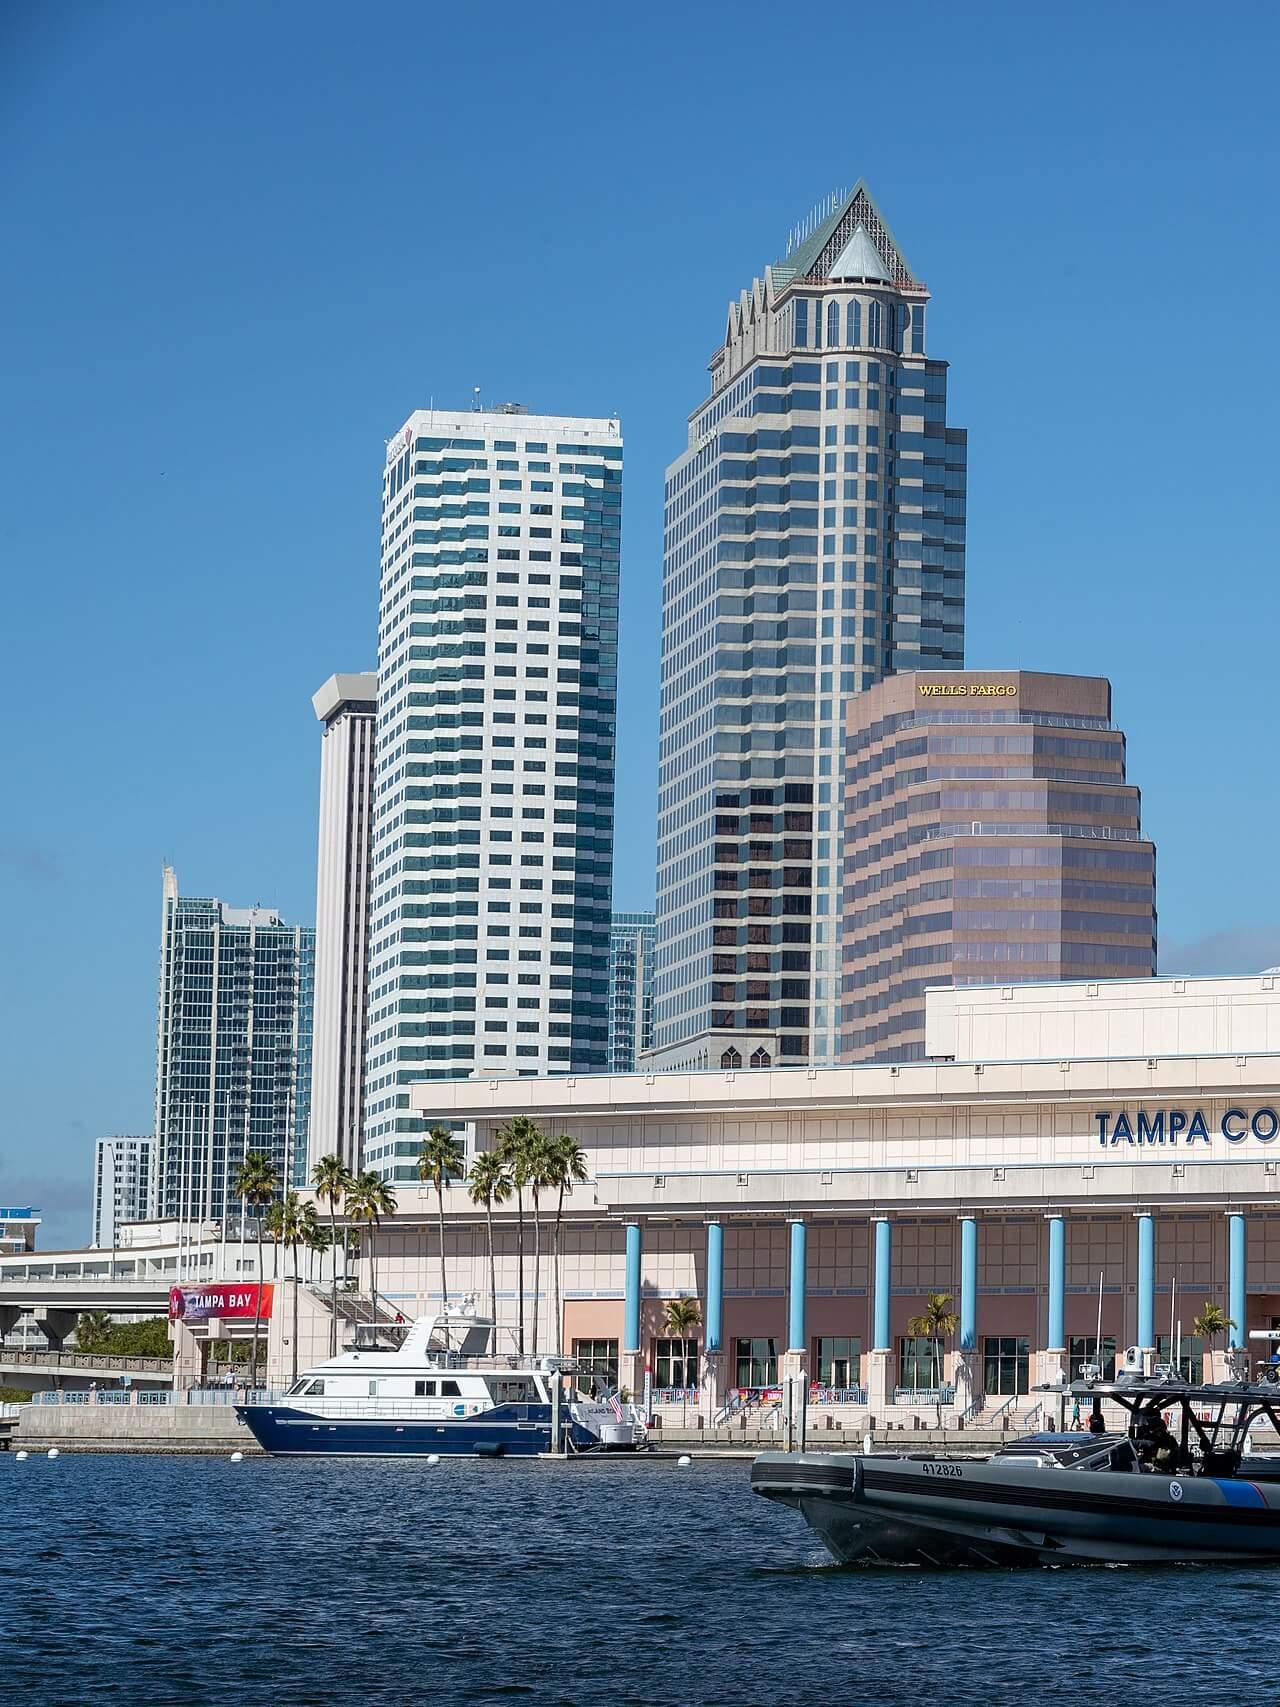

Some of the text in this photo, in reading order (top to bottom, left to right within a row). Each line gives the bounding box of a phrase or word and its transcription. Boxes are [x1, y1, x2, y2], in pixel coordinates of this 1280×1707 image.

[918, 685, 1017, 696] WELLS FARGO
[1095, 1110, 1210, 1145] TAMPA
[195, 1294, 225, 1309] TAMPA
[229, 1293, 252, 1307] BAY
[922, 1463, 963, 1477] 412826
